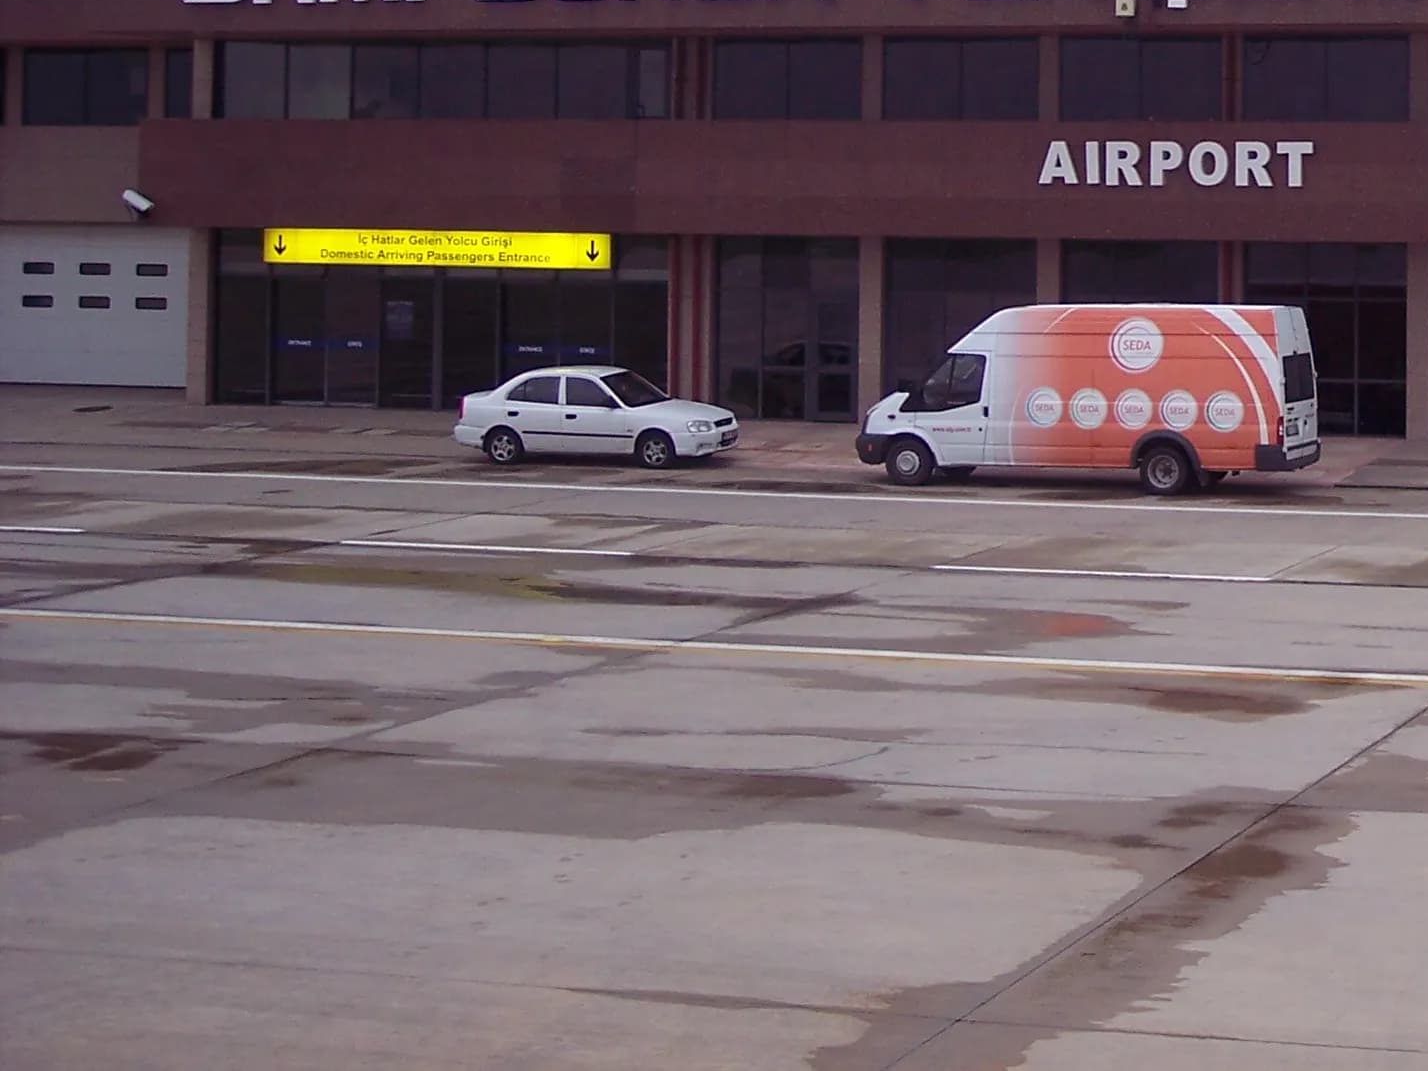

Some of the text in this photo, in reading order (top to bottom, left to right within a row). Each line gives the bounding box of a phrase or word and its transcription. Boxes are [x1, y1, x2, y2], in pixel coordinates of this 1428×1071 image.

[1037, 139, 1315, 188] AIRPORT
[371, 233, 406, 246] Hatlar
[408, 234, 443, 247] Gelen
[446, 235, 478, 247] Yolcu
[481, 235, 513, 249] Girişi
[319, 248, 551, 264] Domestic Arriving Passengers Entrance
[1122, 339, 1152, 351] SEDA
[1034, 404, 1055, 413] SEDA
[1079, 405, 1099, 414] SEDA
[1124, 405, 1145, 414] SEDA
[1169, 406, 1190, 416] SEDA
[1214, 408, 1236, 417] SEDA
